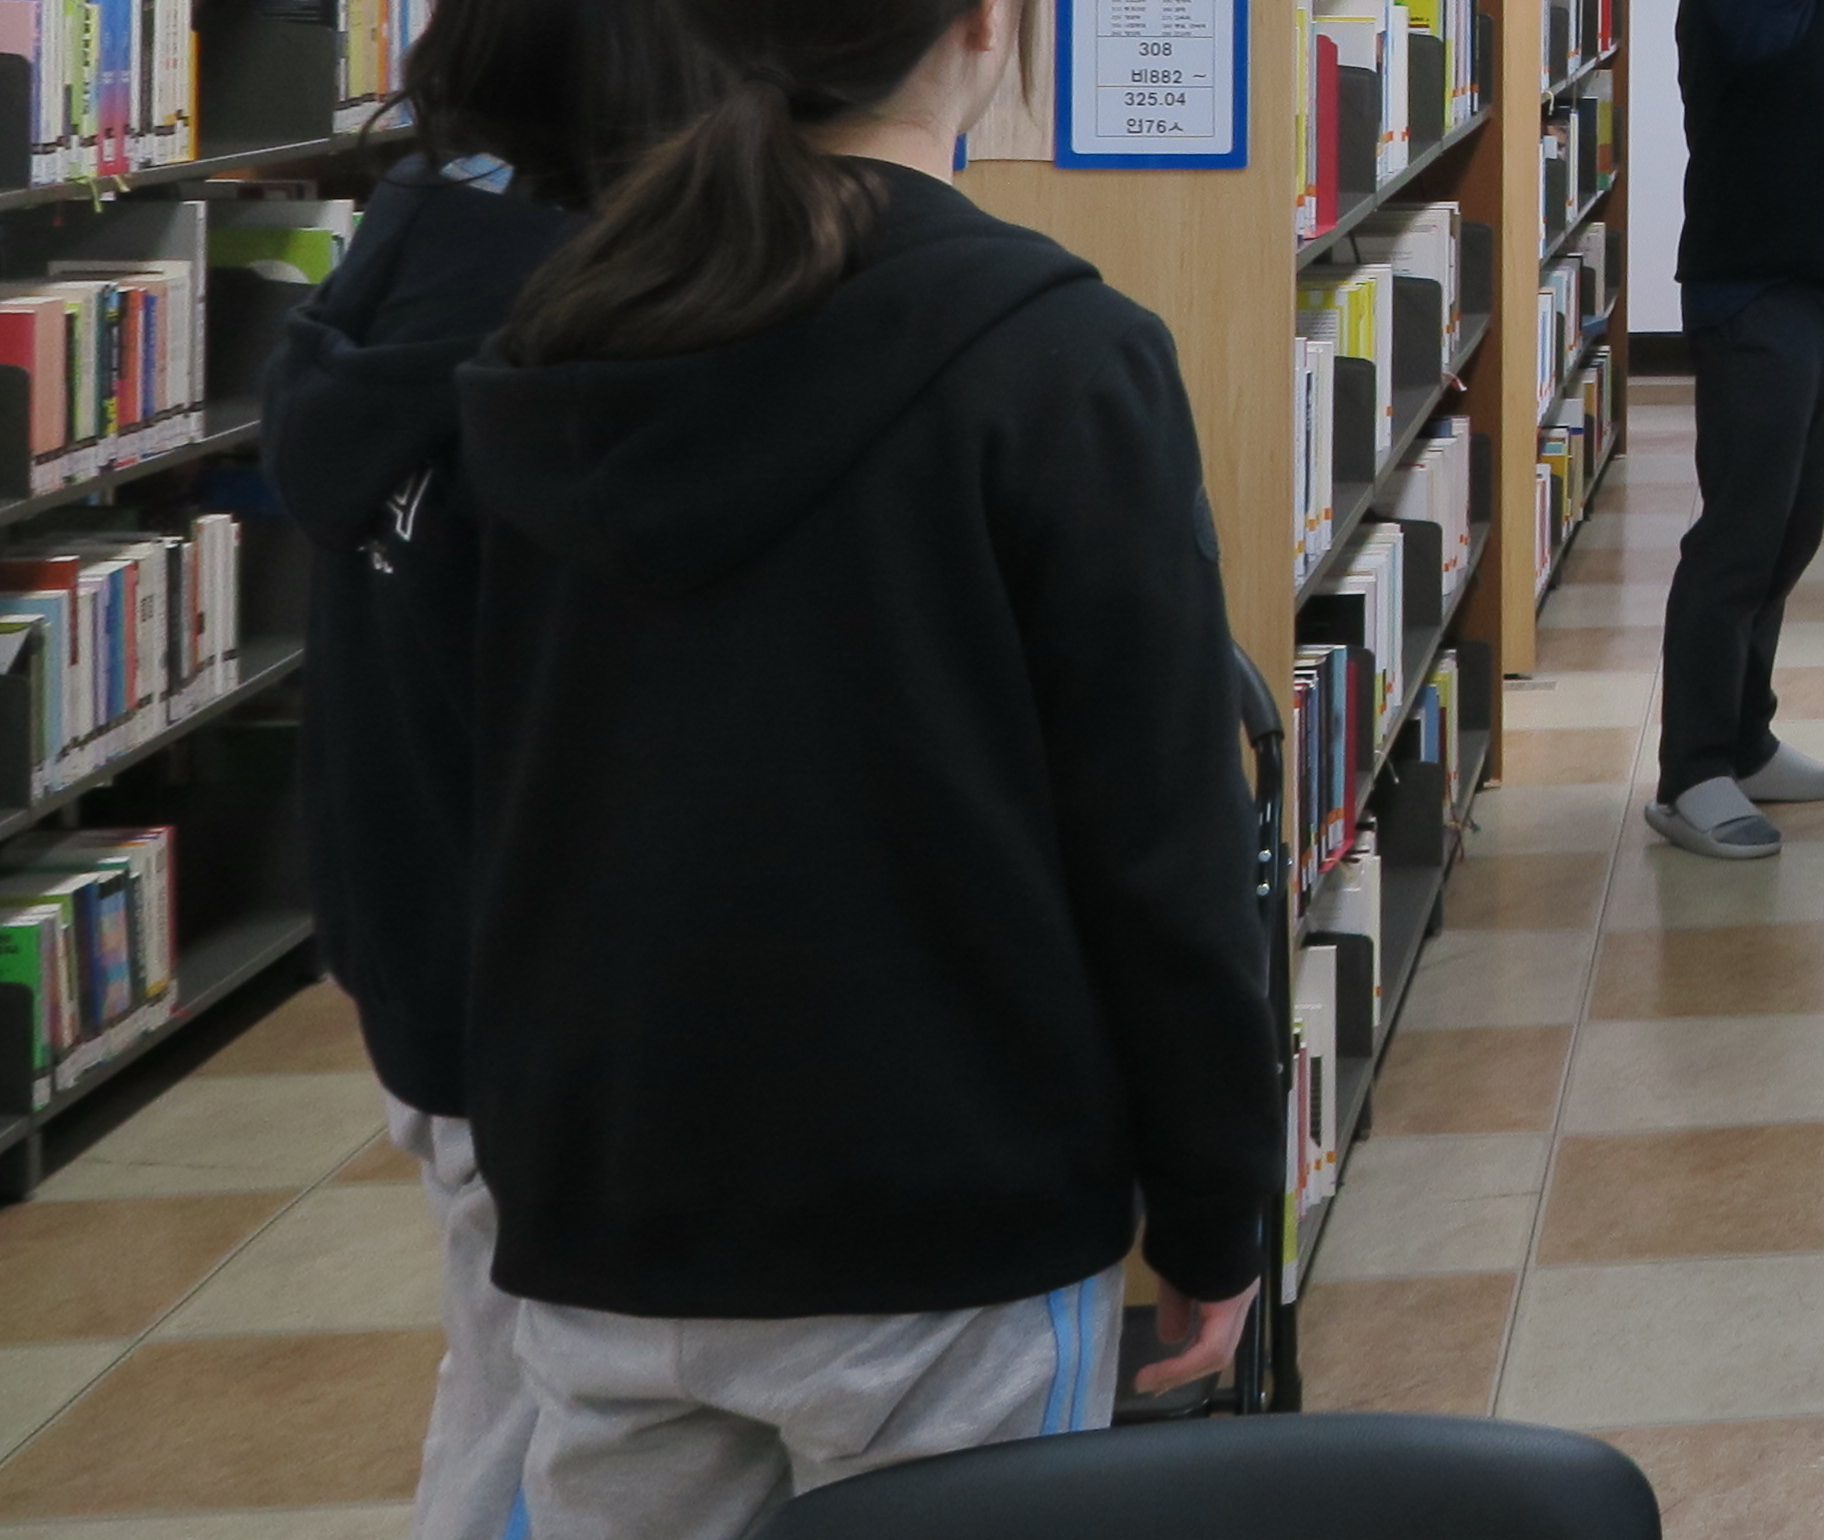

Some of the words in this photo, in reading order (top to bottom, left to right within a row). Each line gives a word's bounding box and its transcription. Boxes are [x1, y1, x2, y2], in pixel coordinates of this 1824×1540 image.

[1138, 42, 1173, 57] 308
[1131, 69, 1183, 84] 비882
[1124, 92, 1187, 106] 325.04
